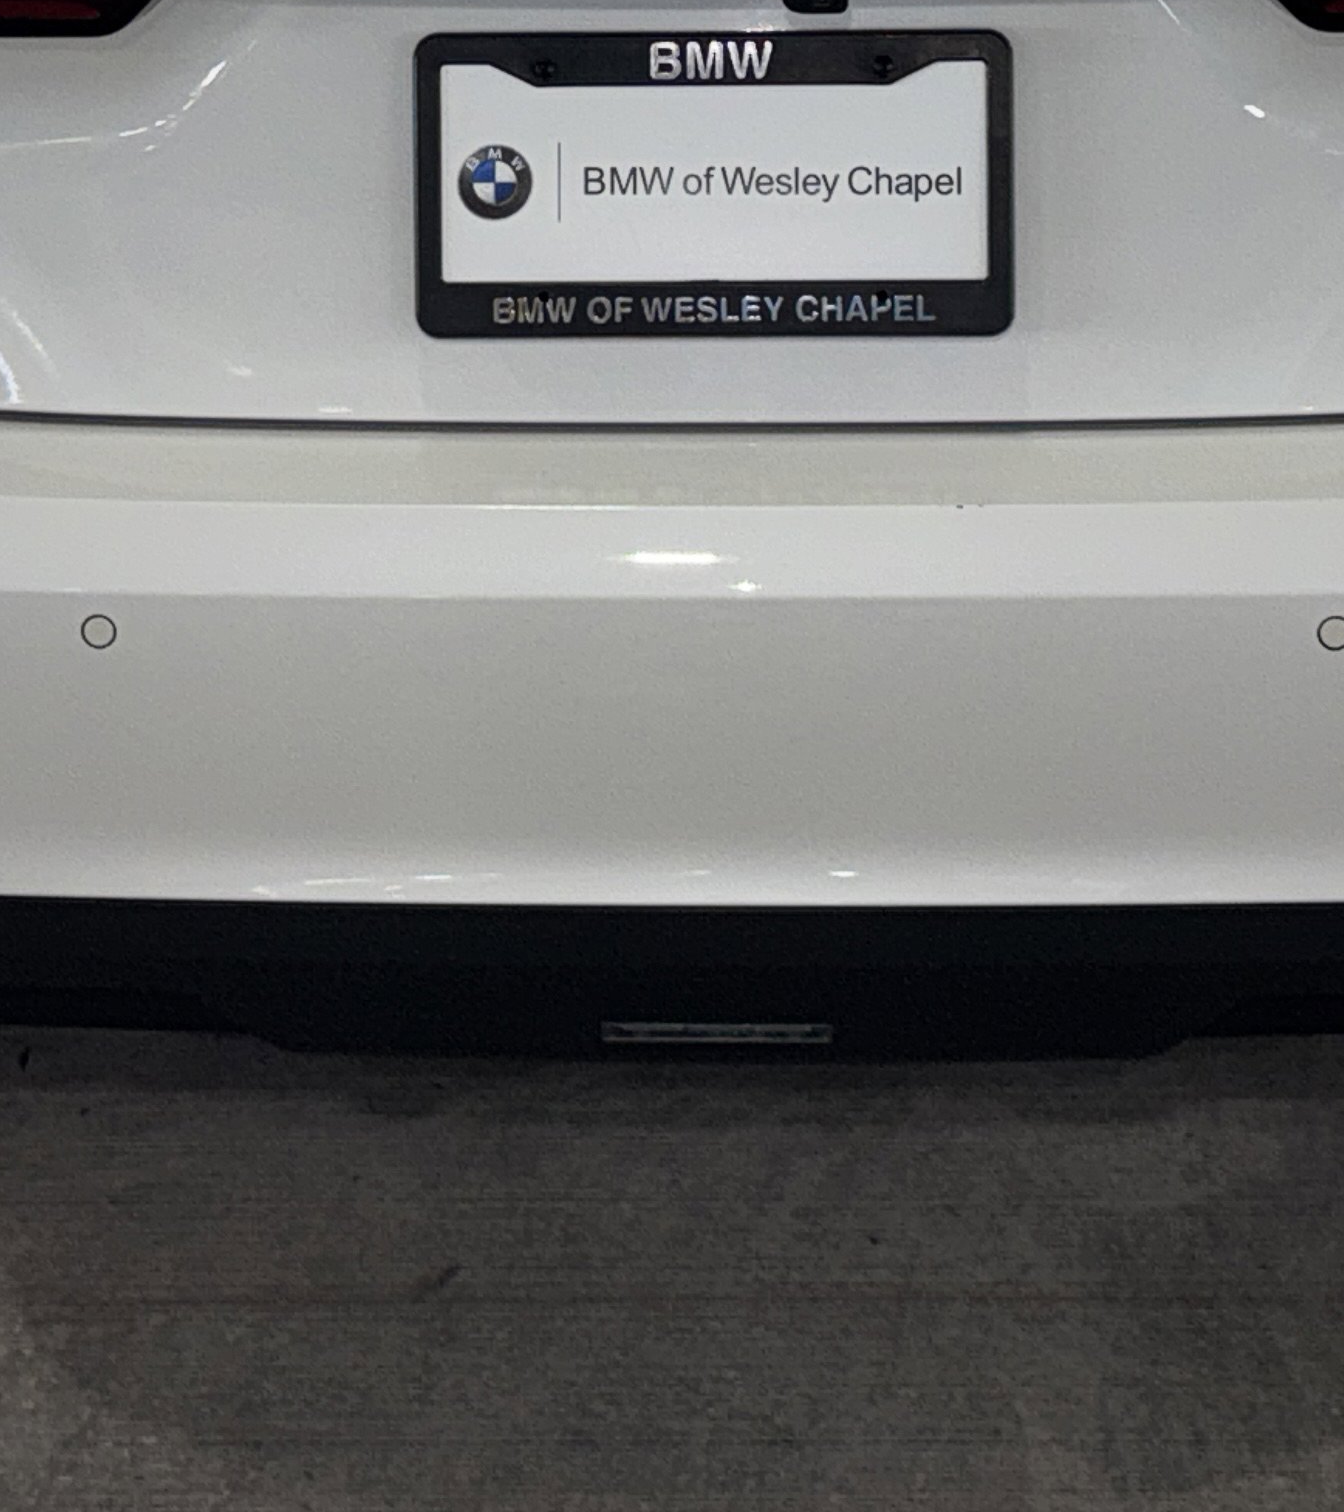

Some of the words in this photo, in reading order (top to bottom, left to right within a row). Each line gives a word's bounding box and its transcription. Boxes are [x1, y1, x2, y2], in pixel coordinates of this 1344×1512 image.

[648, 40, 773, 80] BMW
[582, 166, 674, 195] BMW
[682, 166, 716, 195] of
[721, 166, 840, 203] Wesley
[847, 166, 963, 202] Chapel
[492, 296, 577, 324] BMW
[587, 296, 633, 324] OF
[640, 295, 784, 323] WESLEY
[795, 294, 937, 323] CHAPEL
